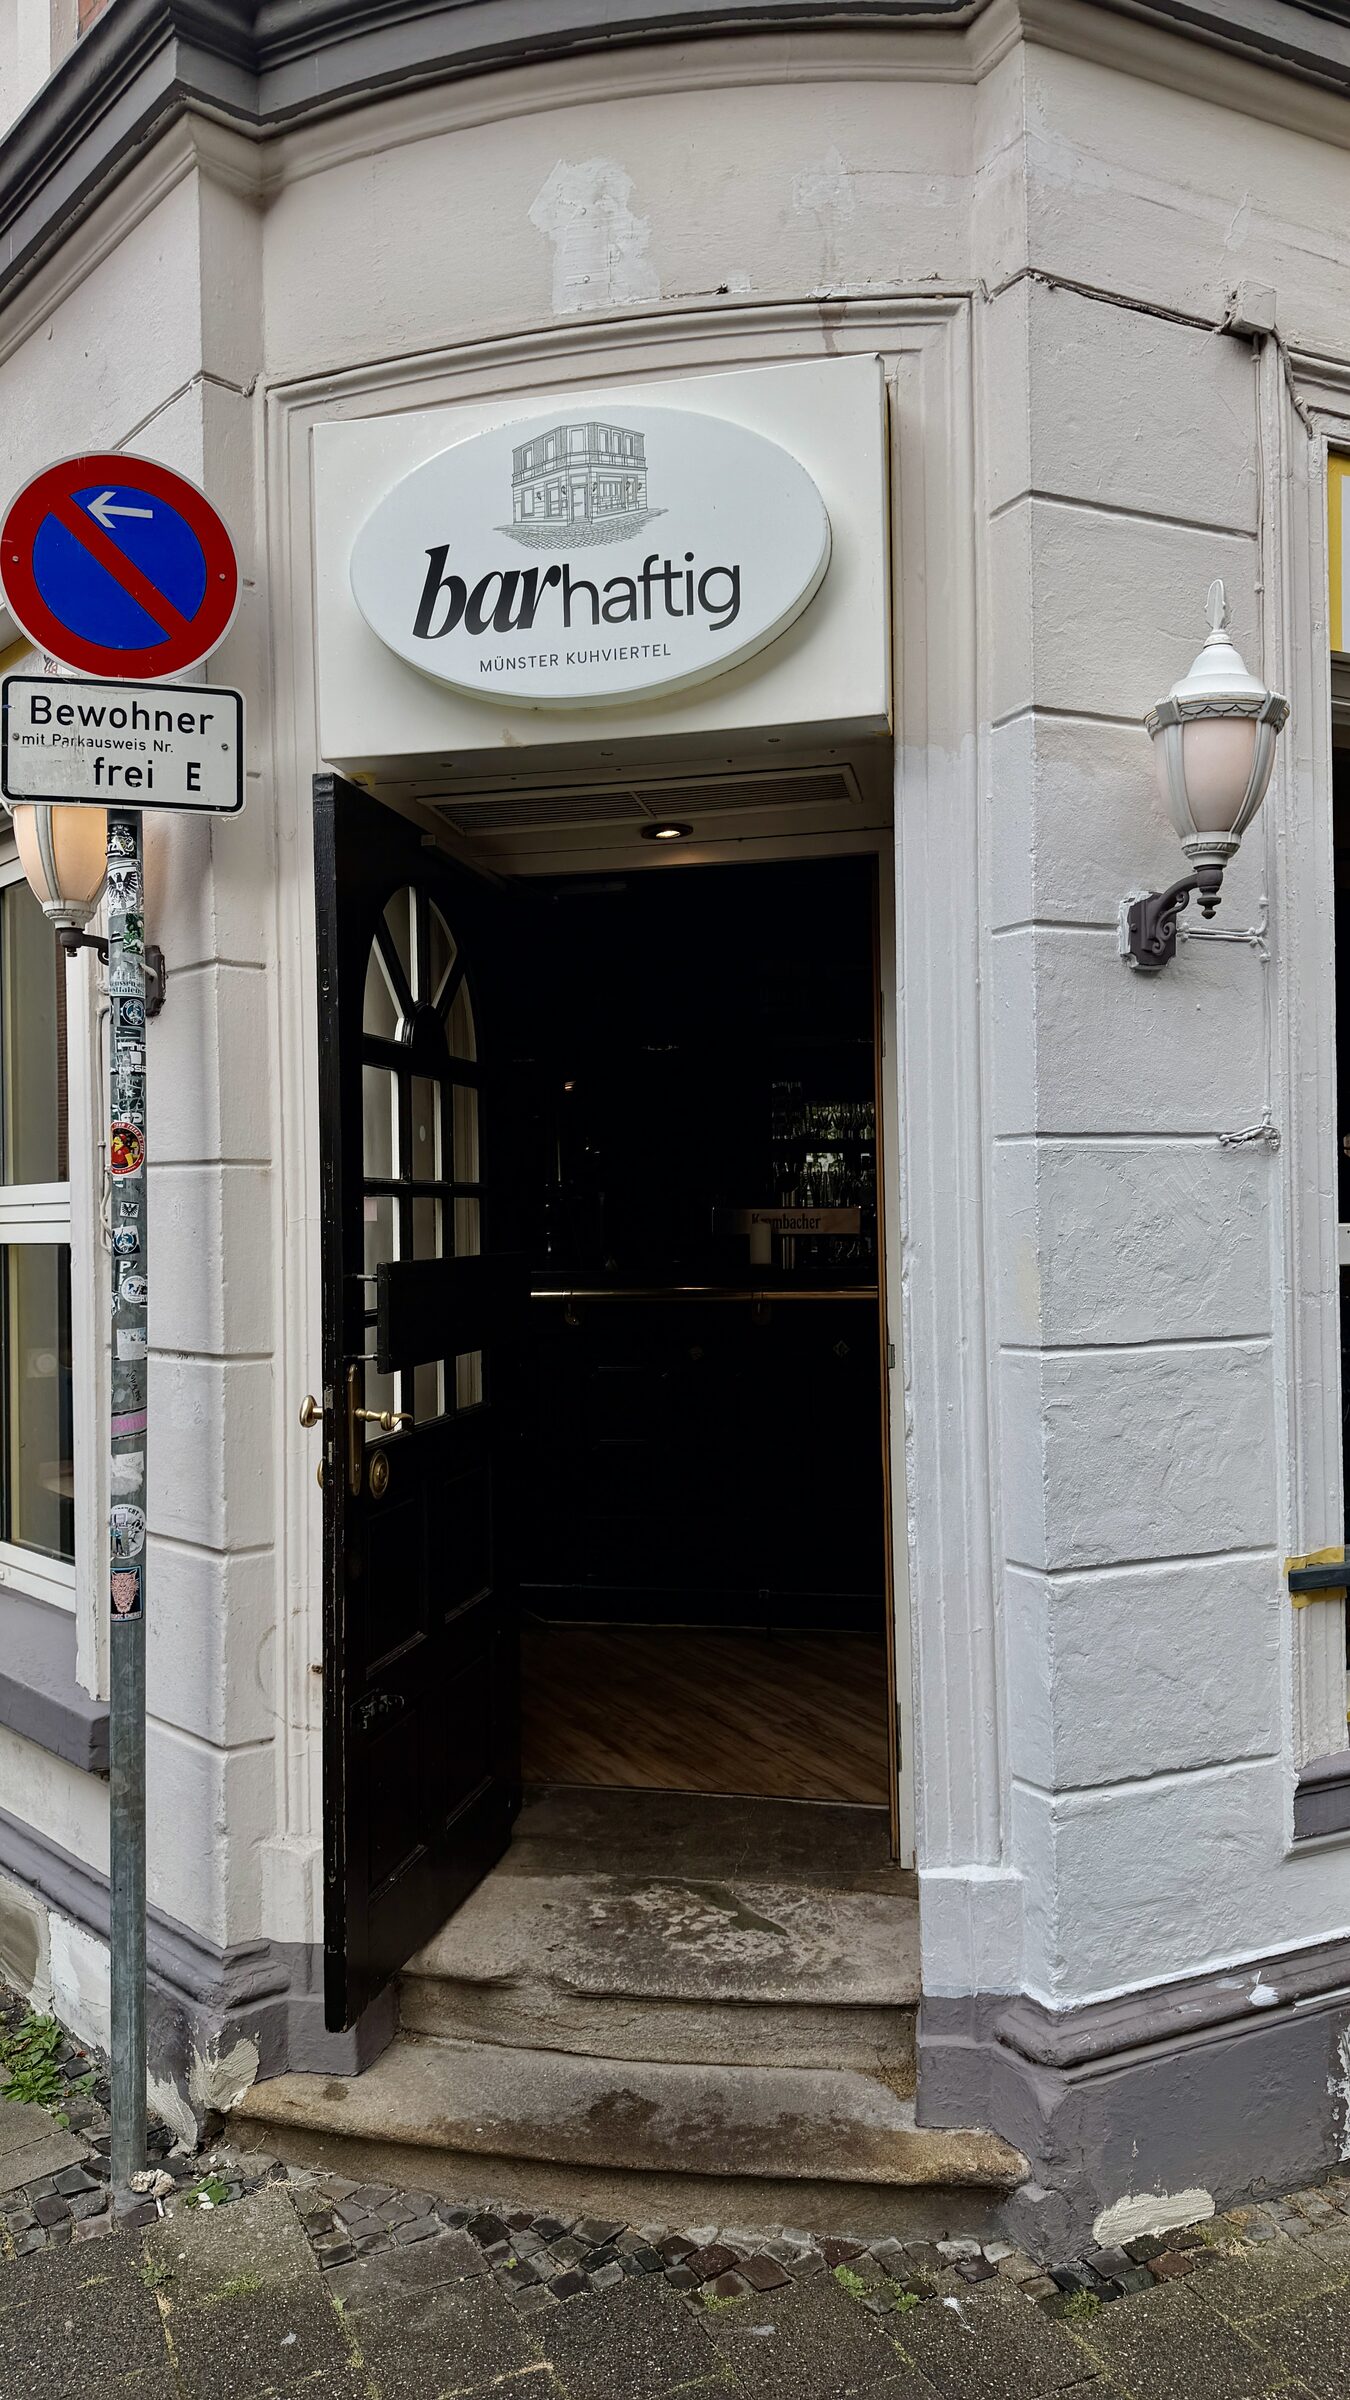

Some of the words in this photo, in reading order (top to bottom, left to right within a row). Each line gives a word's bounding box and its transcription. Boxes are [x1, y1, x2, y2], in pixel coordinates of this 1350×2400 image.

[412, 543, 741, 640] barhaftig
[479, 653, 559, 673] MÜNSTER
[566, 643, 672, 665] KUHVIERTEL
[31, 695, 214, 735] Bewohner
[21, 733, 45, 746] mit
[52, 734, 146, 751] Parkausweis
[153, 740, 174, 753] Nr.
[93, 756, 153, 789] frei
[186, 762, 201, 791] E
